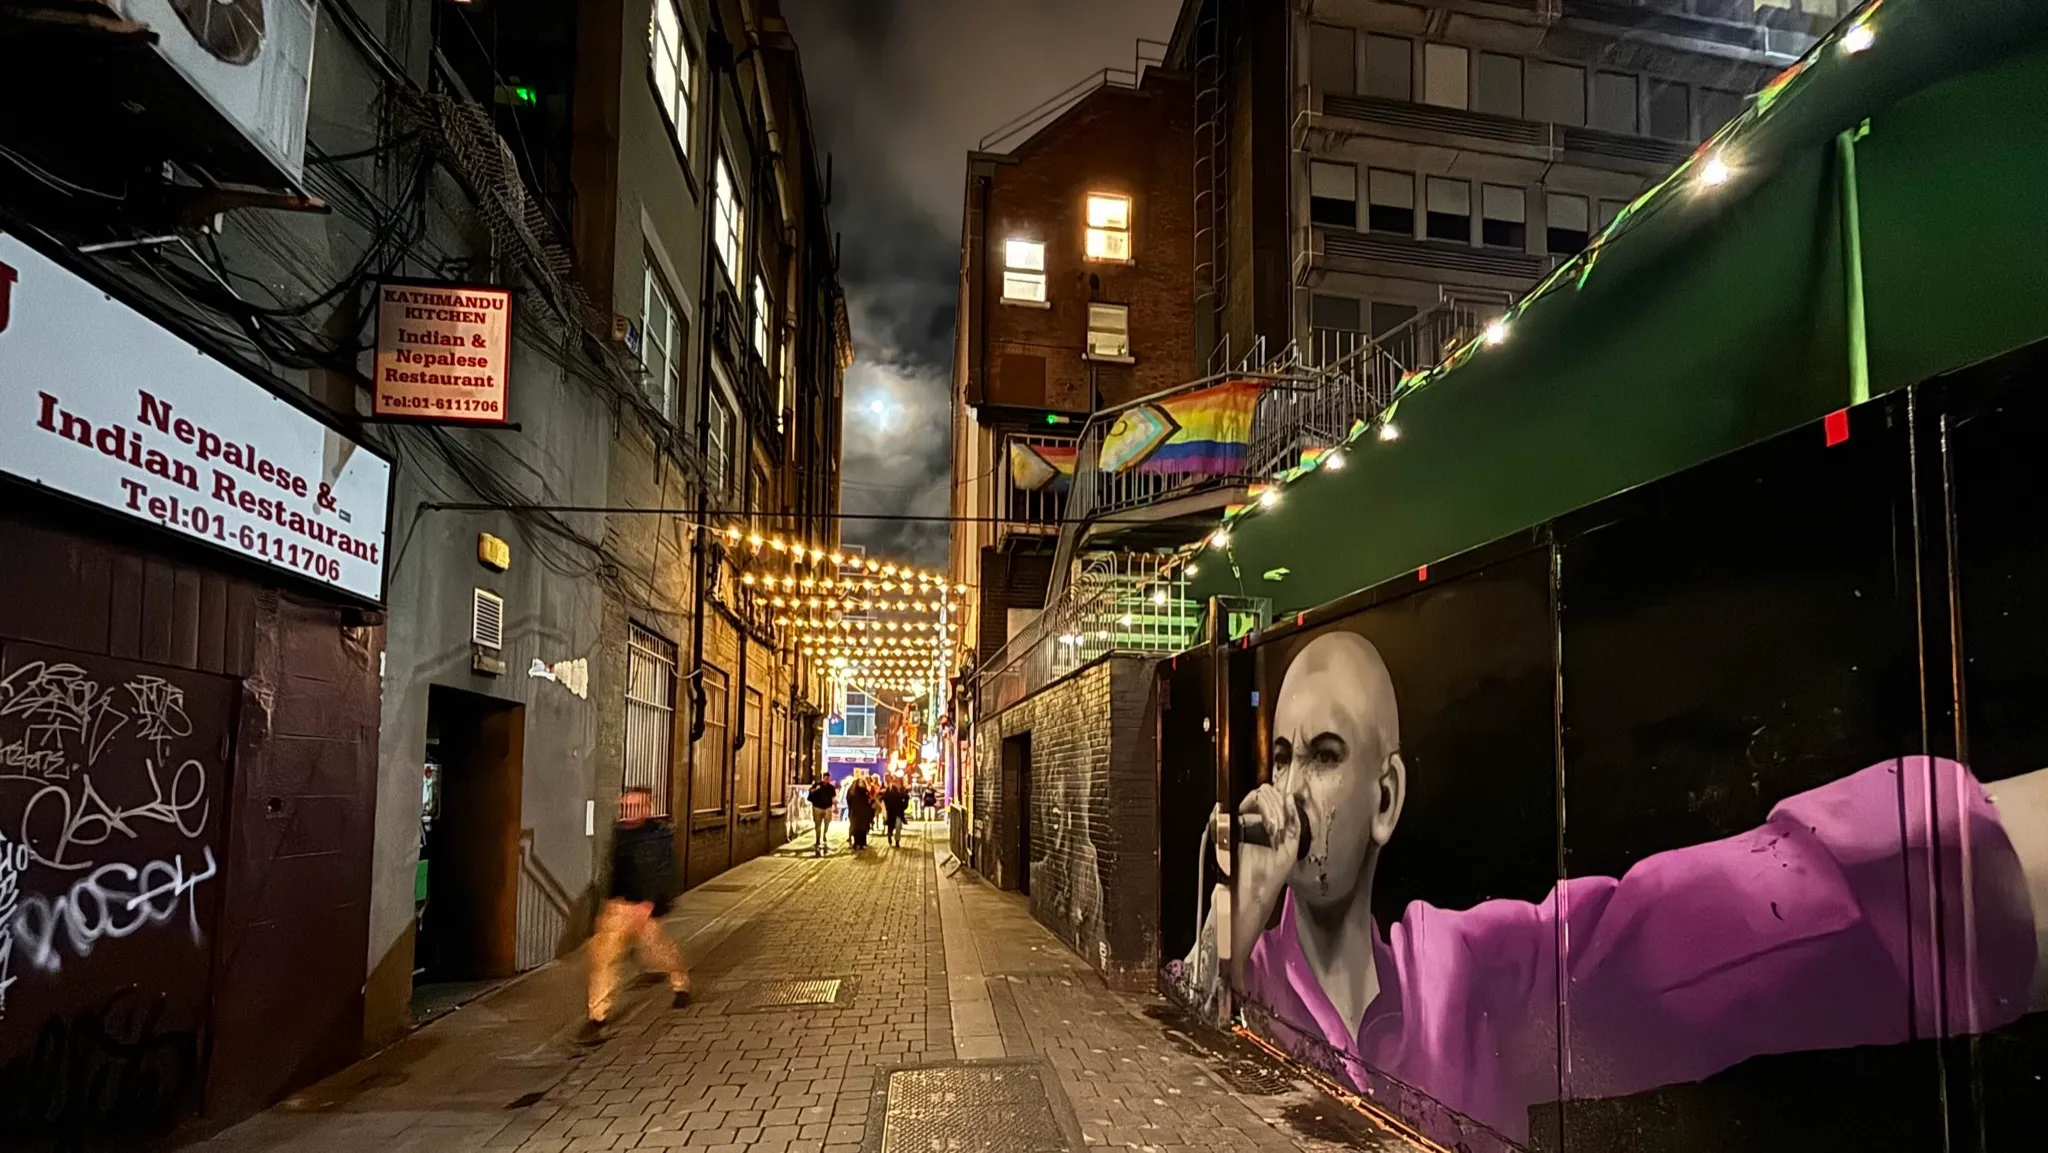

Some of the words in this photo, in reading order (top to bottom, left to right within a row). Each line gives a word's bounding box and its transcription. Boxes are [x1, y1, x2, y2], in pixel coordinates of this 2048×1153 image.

[384, 290, 504, 310] KATHMANDU
[405, 307, 486, 324] KITCHEN
[398, 328, 465, 347] Indian
[471, 333, 487, 349] &
[396, 349, 488, 367] Nepalese
[385, 367, 494, 388] Restaurant
[382, 395, 499, 413] Tel:01-6111706
[137, 389, 308, 499] Nepalese
[316, 482, 337, 512] &
[37, 391, 199, 491] Indian
[212, 468, 379, 564] Restaurant
[121, 478, 340, 581] Tel:01-6111706
